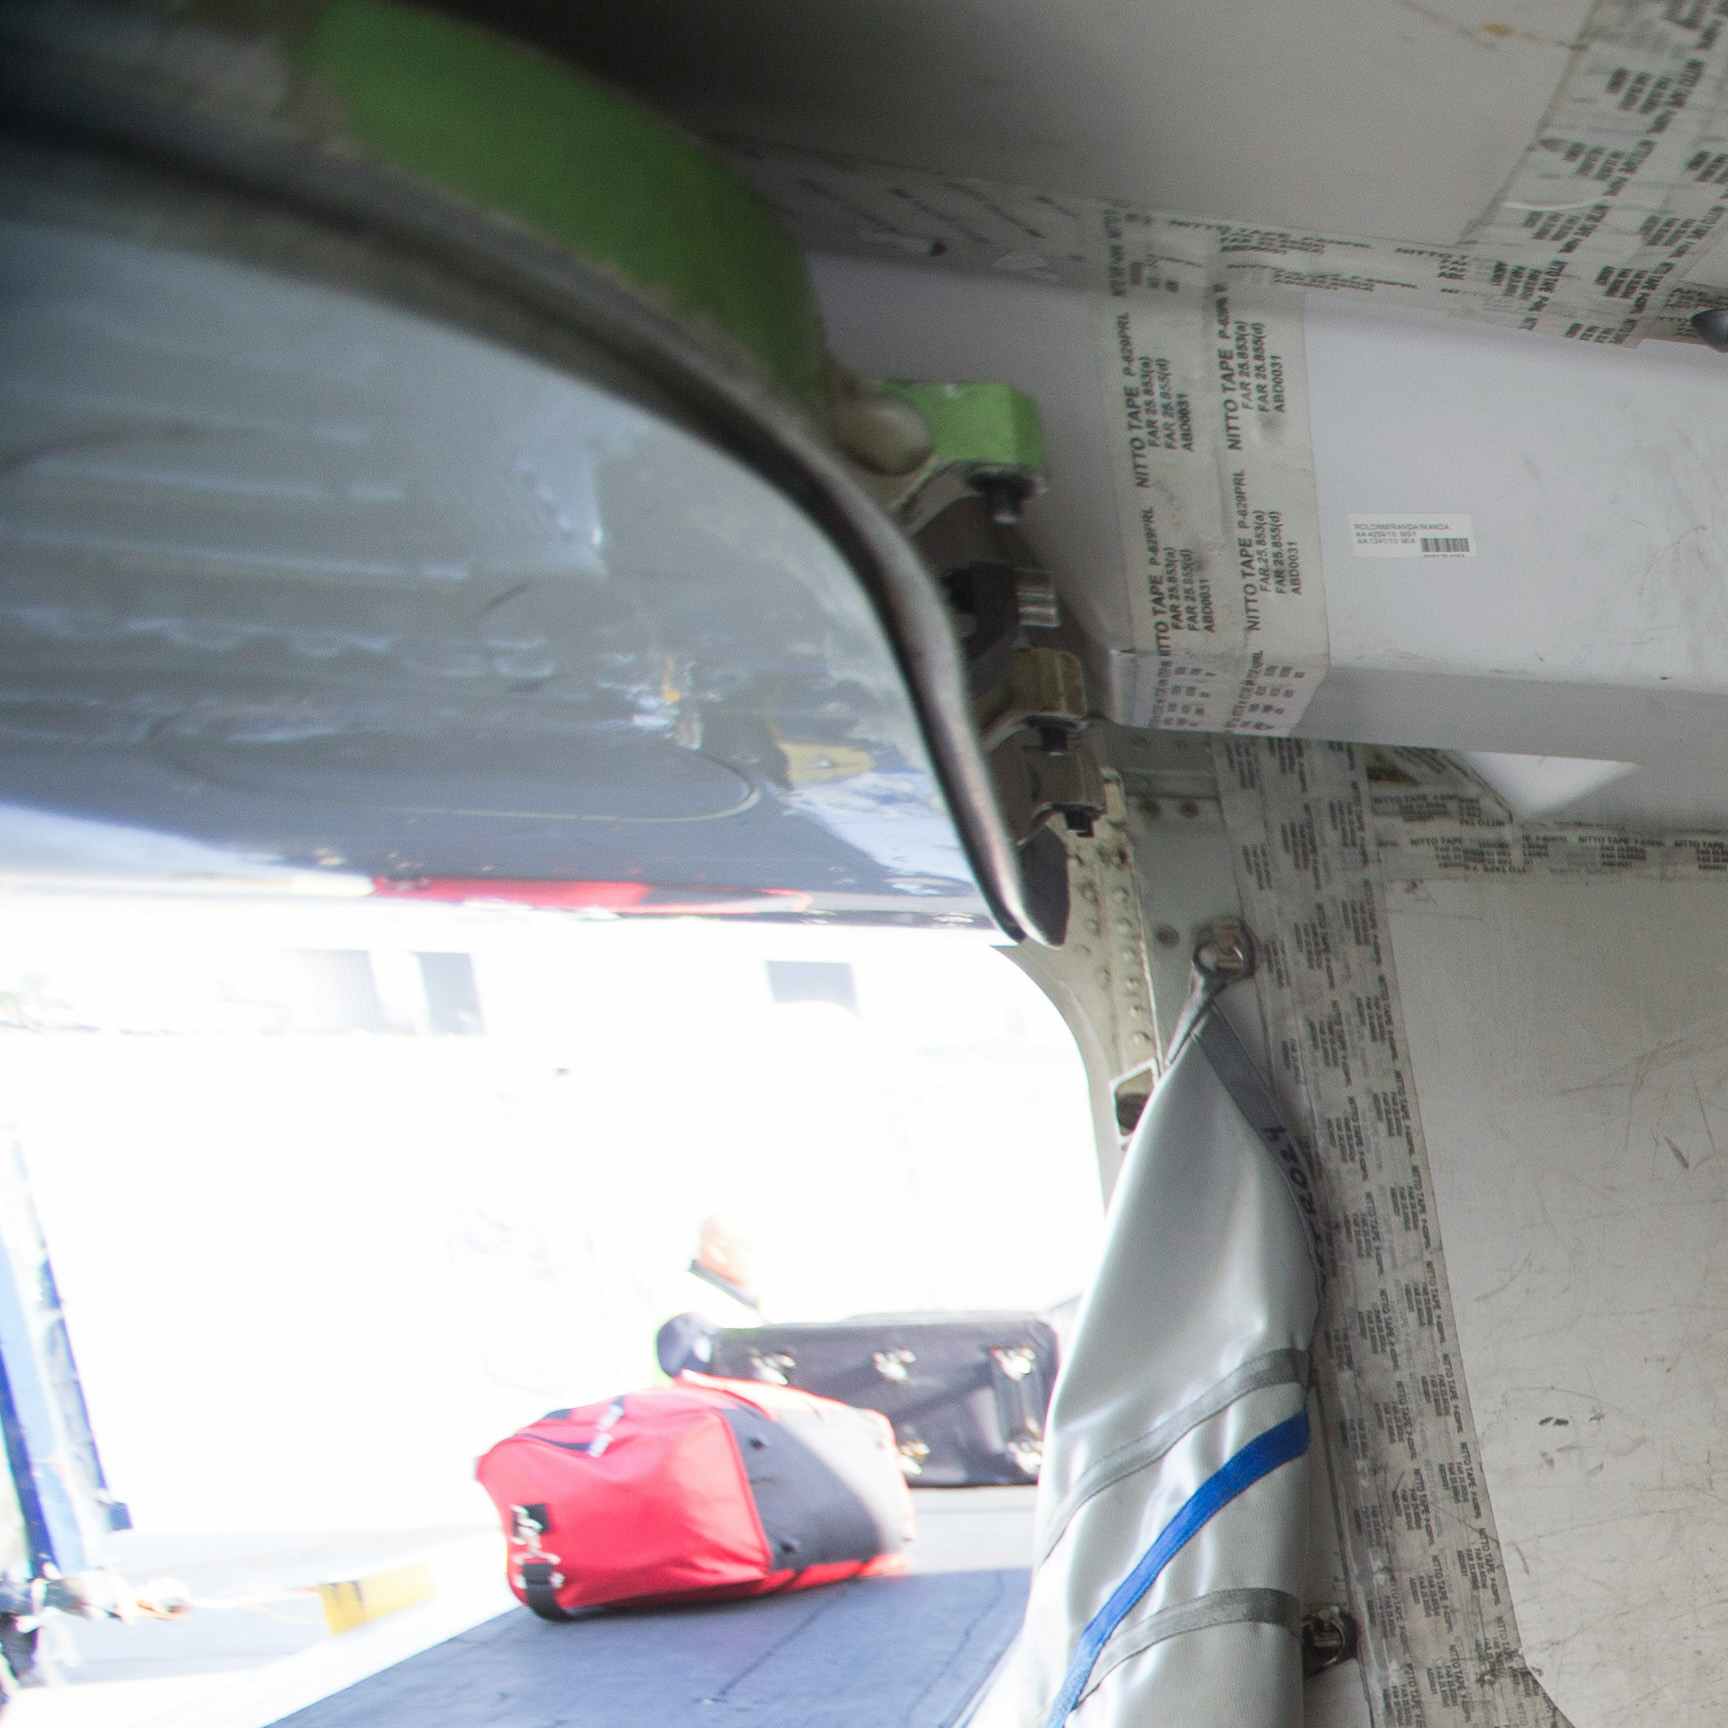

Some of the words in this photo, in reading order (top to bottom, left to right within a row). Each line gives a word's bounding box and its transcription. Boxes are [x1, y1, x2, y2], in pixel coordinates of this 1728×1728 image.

[1224, 399, 1242, 450] NITTO
[1238, 538, 1256, 579] TAPE
[1149, 574, 1167, 617] TAPE
[1243, 583, 1261, 631] NITTO
